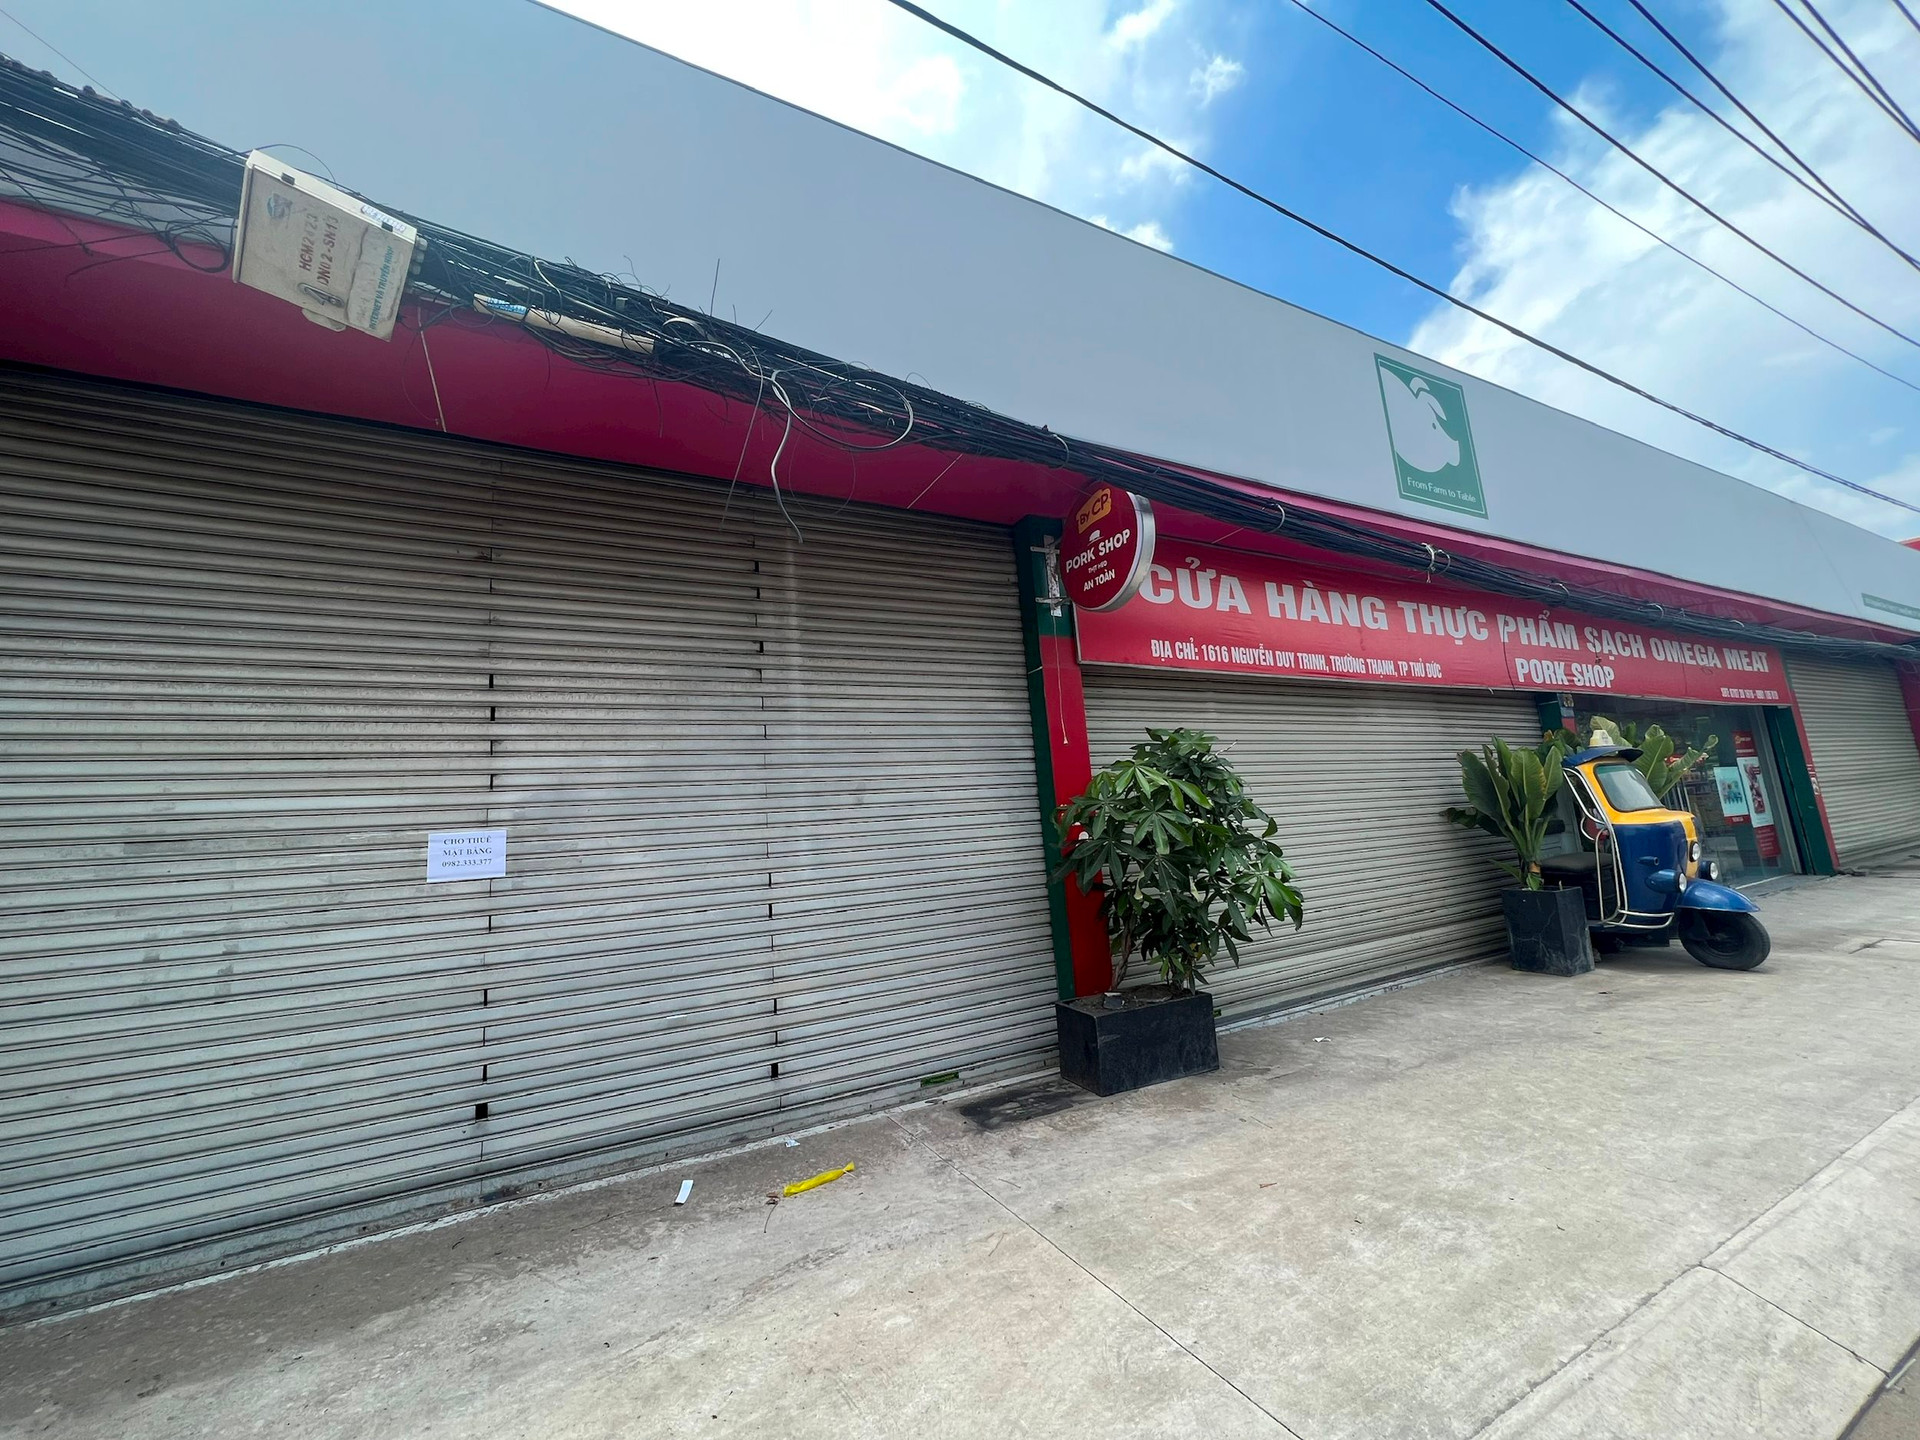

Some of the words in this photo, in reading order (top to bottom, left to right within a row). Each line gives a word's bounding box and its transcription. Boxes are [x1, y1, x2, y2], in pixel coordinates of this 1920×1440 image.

[369, 299, 381, 330] INTERNET
[1407, 476, 1428, 491] From
[1428, 482, 1448, 496] Farm
[1448, 489, 1456, 498] to
[1456, 490, 1477, 503] Table
[1091, 493, 1109, 516] CP
[1065, 547, 1096, 573] PORK
[1098, 528, 1131, 556] SHOP
[1083, 579, 1094, 592] AN
[1094, 568, 1116, 586] TOÀN
[1138, 556, 1252, 615] CỬA
[1264, 579, 1389, 631] HÀNG
[1396, 600, 1489, 645] THỰC
[1496, 609, 1580, 651] PHẨM
[1584, 626, 1647, 661] SẠCH
[1649, 637, 1722, 669] OMEGA
[1722, 647, 1770, 673] MEAT
[1151, 639, 1173, 662] ĐỊA
[1174, 637, 1199, 661] CHỈ:
[1201, 644, 1230, 664] 1616
[1231, 643, 1275, 667] NGUYỄN
[1276, 650, 1296, 669] DUY
[1297, 652, 1330, 673] TRINH,
[1329, 653, 1367, 674] TRƯỜNG
[1366, 658, 1398, 679] THẠNH,
[1397, 660, 1408, 677] TP
[1409, 658, 1426, 678] THỦ
[1426, 660, 1443, 679] ĐỨC
[1515, 657, 1569, 685] PORK
[1571, 662, 1615, 688] SHOP
[467, 835, 492, 844] THUÊ
[441, 858, 492, 867] 0982.333.377
